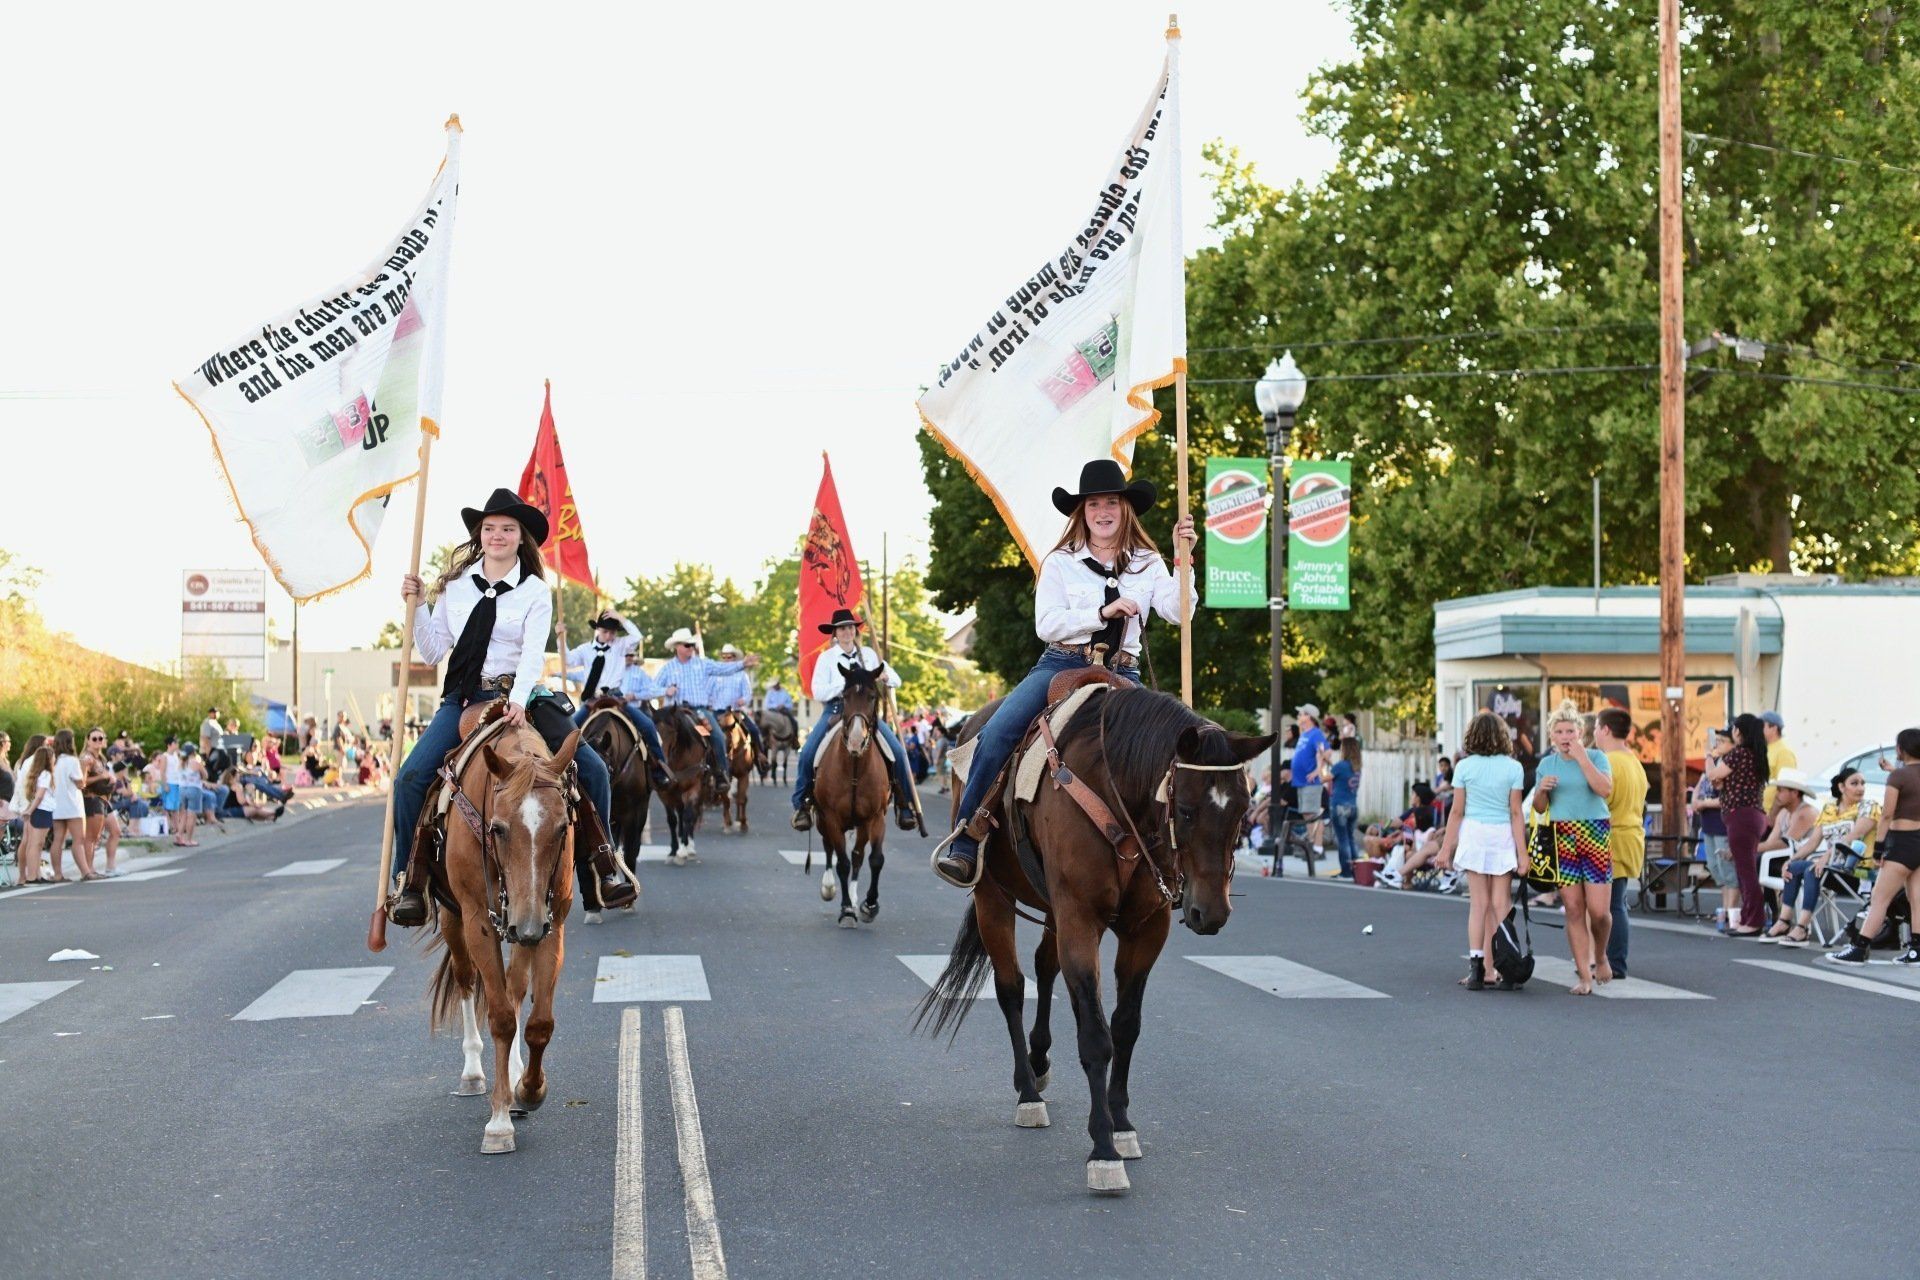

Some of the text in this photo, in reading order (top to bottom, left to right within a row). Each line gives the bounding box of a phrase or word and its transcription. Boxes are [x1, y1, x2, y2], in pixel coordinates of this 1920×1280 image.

[263, 324, 299, 353] the
[295, 291, 360, 337] chutes
[384, 228, 429, 272] made
[238, 362, 282, 404] and
[274, 353, 315, 380] the
[308, 326, 357, 362] men
[351, 303, 387, 338] are
[344, 402, 362, 429] 3
[1208, 488, 1260, 515] DOWNTOWN
[1292, 491, 1343, 518] DOWNTOWN
[1209, 566, 1251, 582] Bruce
[1293, 560, 1344, 574] Jimmy's
[1299, 571, 1337, 583] Johns
[1292, 582, 1345, 594] Portable
[1300, 593, 1339, 605] Toilets
